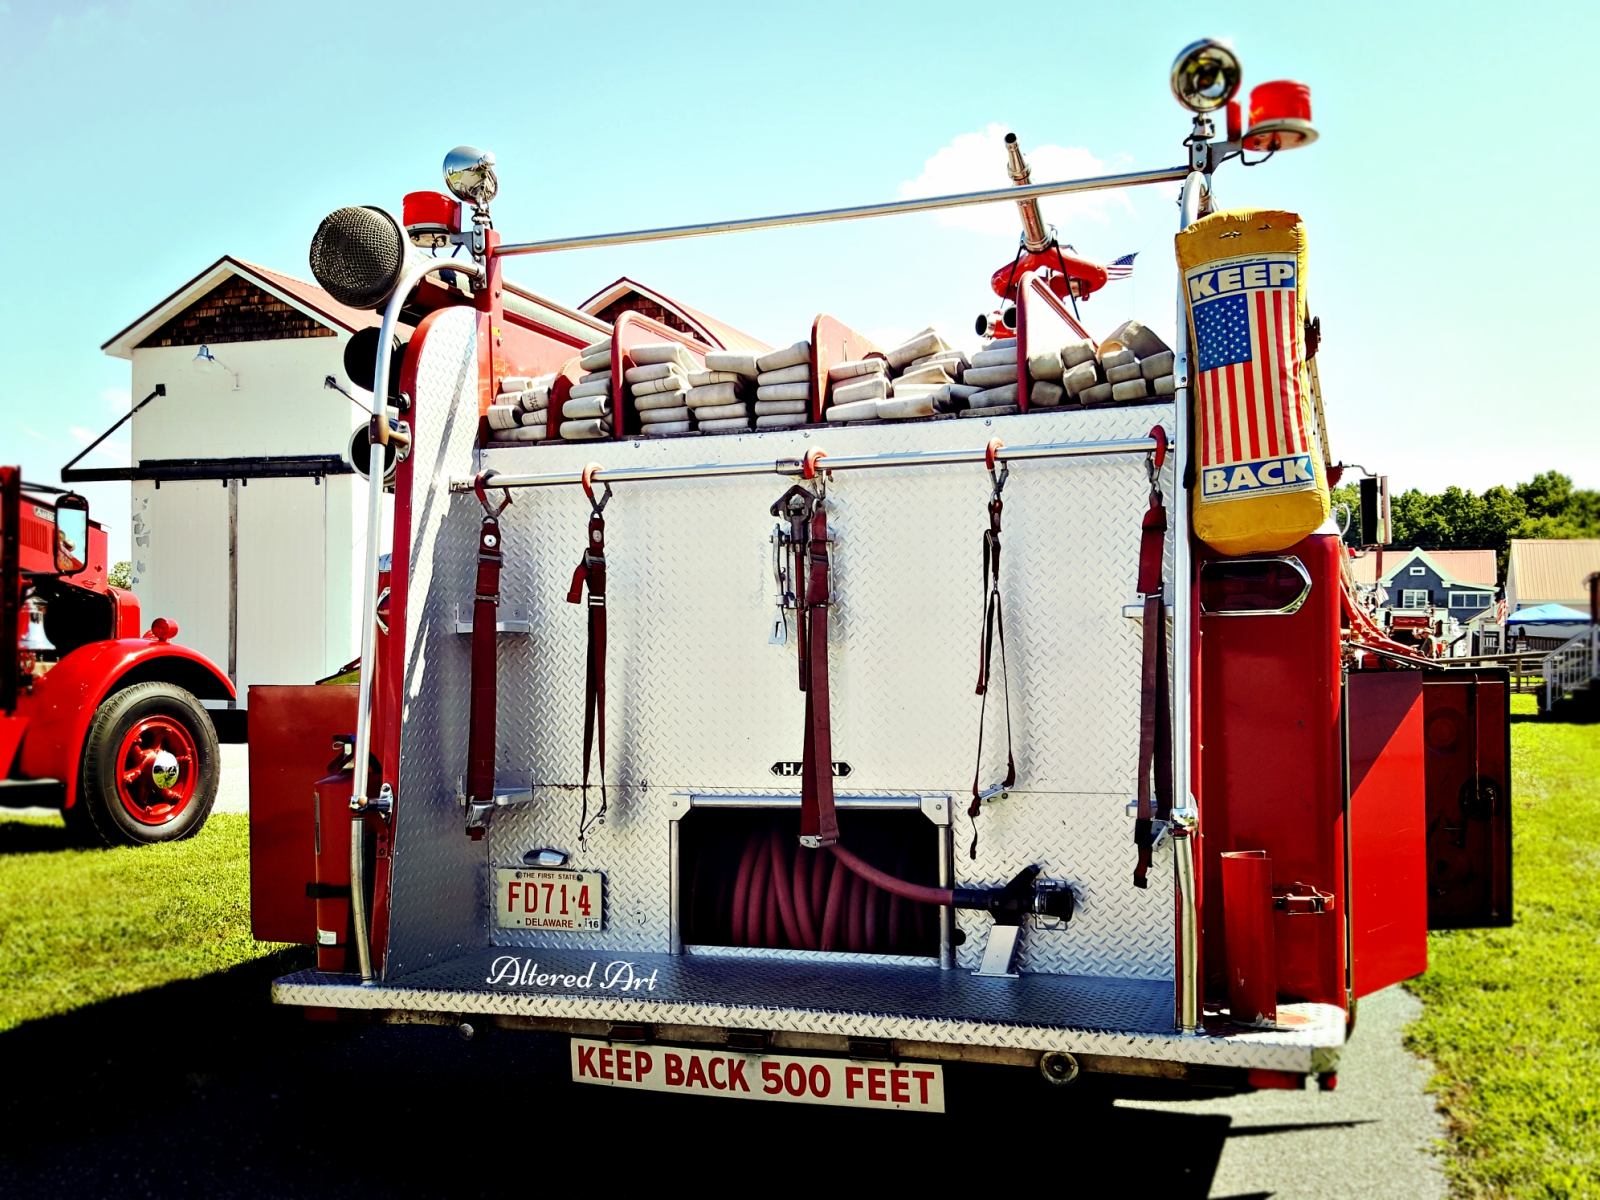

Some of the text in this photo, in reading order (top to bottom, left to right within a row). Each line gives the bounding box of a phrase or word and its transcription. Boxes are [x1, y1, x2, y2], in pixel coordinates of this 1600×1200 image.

[1189, 263, 1294, 302] KEEP
[1204, 458, 1313, 494] BACK
[782, 762, 840, 776] HN
[557, 873, 577, 881] STATE
[525, 917, 574, 929] DELAWARE
[588, 920, 599, 929] 16
[577, 1045, 935, 1105] KEEP BACK 500 FEET
